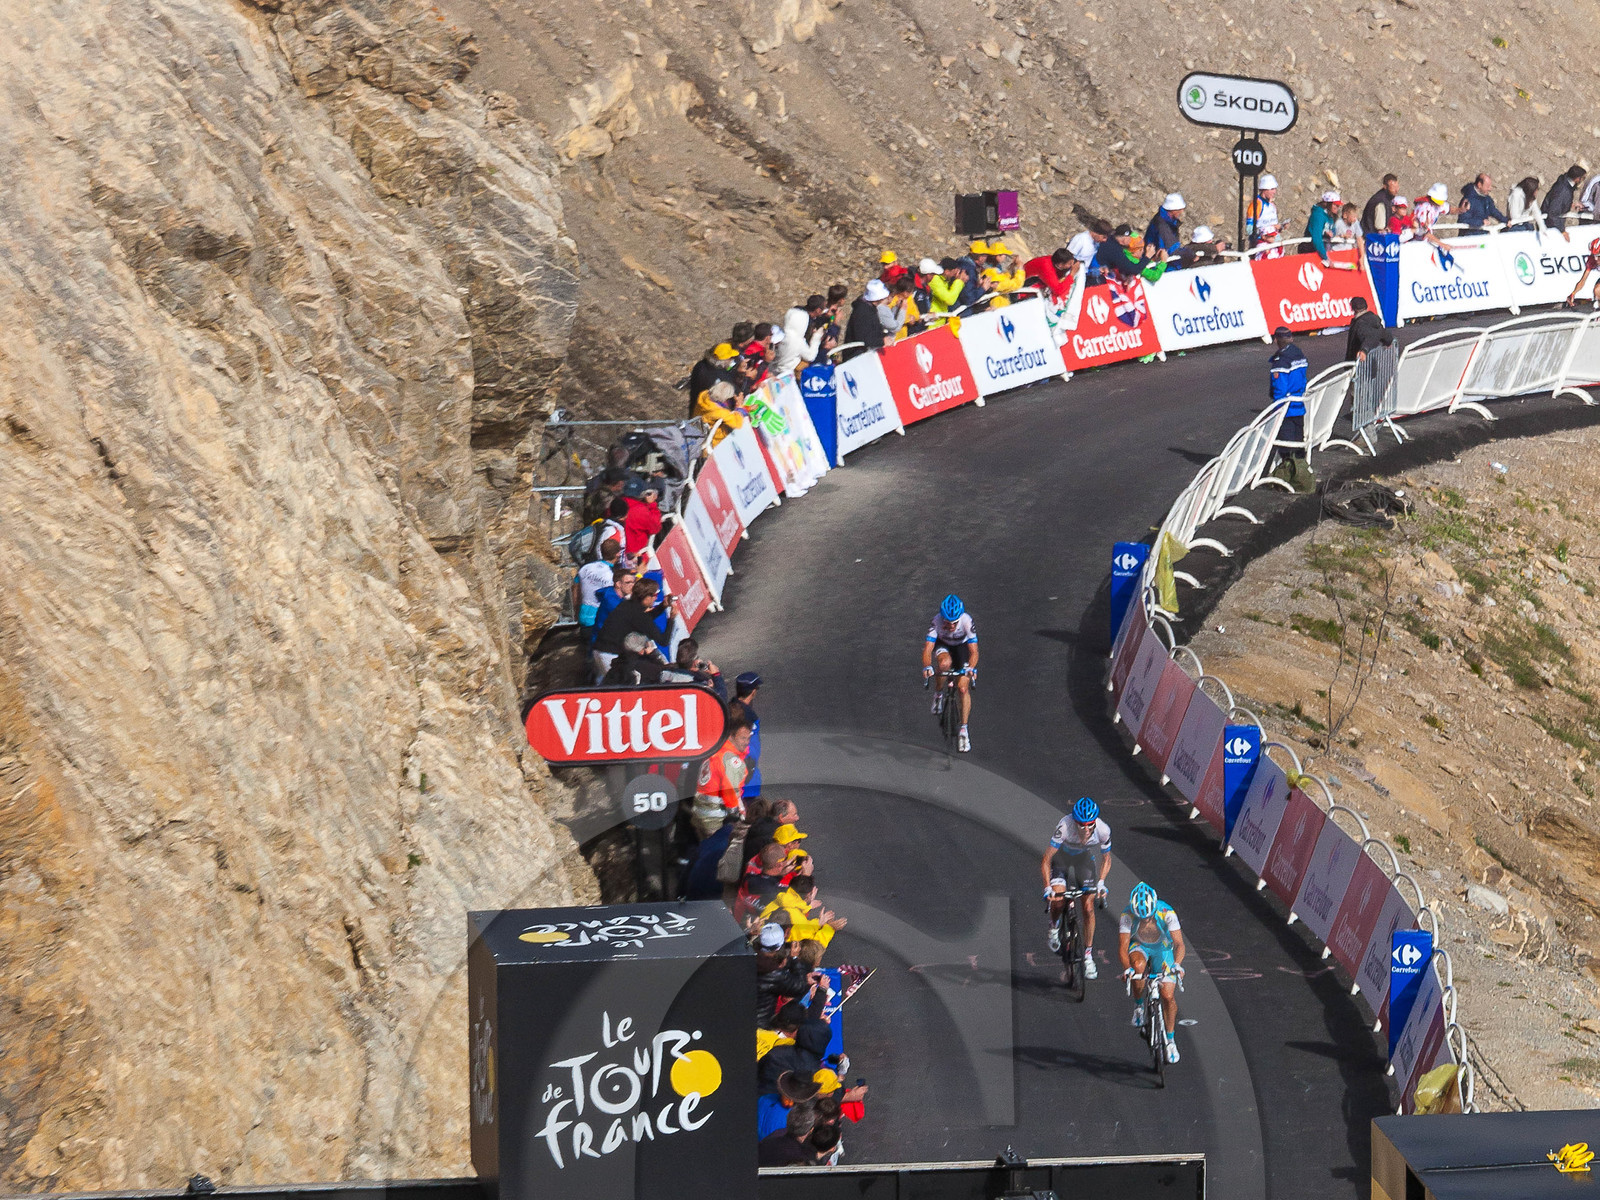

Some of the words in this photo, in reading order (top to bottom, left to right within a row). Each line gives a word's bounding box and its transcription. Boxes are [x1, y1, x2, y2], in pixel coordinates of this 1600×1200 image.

[1214, 90, 1288, 116] ŠKODA
[1233, 149, 1263, 166] 100
[1540, 253, 1592, 275] ŠKO
[1411, 276, 1489, 304] Carrefour
[1172, 306, 1244, 337] Carrefour
[1072, 326, 1143, 360] Carrefour
[986, 346, 1048, 380] Carrefour
[908, 374, 964, 410] Carrefour
[839, 401, 886, 437] Carrefour
[542, 694, 703, 756] Vittel
[633, 792, 668, 813] 50
[541, 1083, 564, 1104] de
